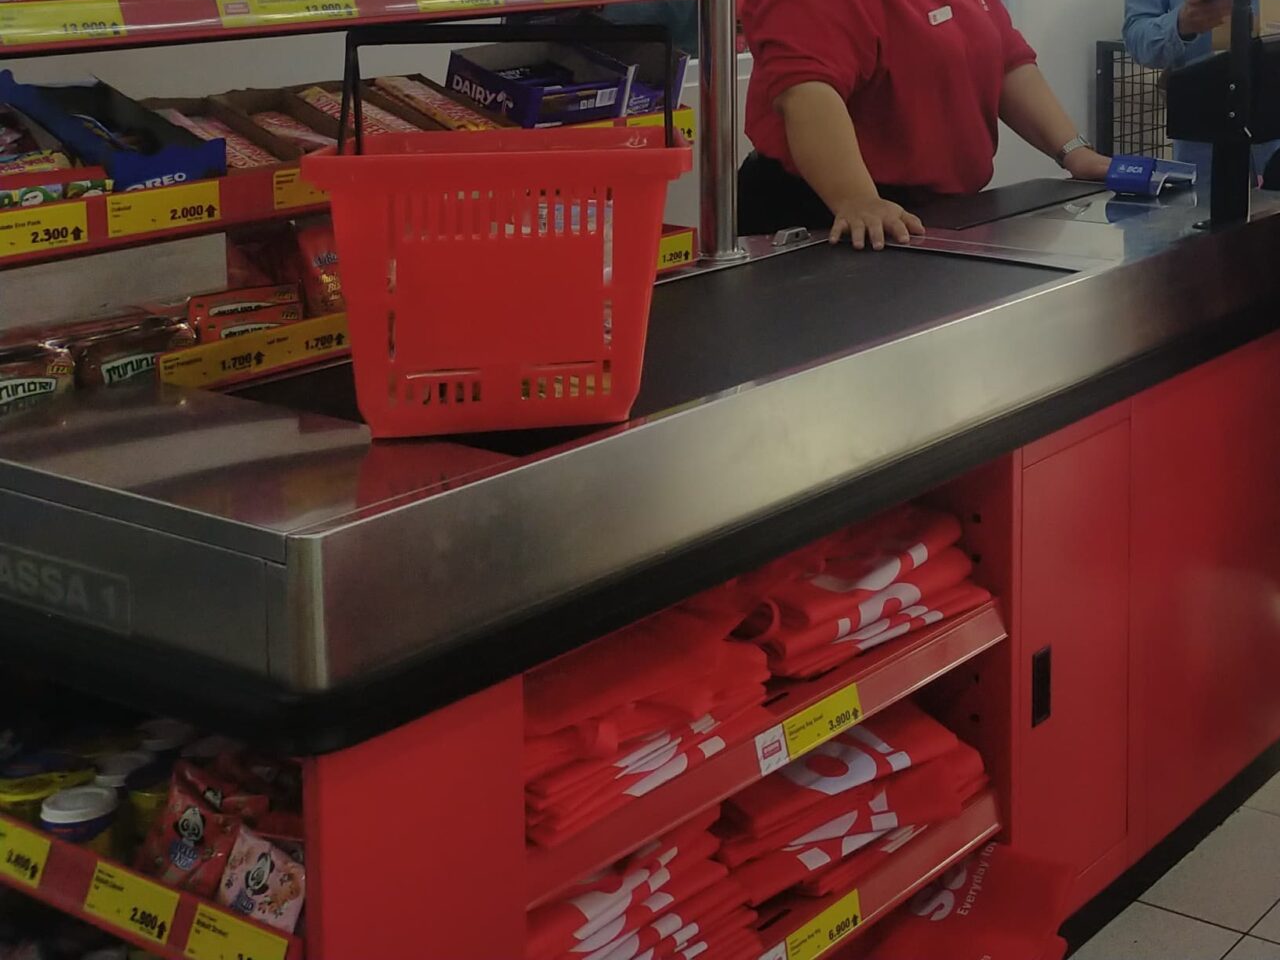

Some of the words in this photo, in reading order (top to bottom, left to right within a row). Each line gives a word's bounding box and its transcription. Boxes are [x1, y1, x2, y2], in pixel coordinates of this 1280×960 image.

[452, 74, 496, 106] DAIRY
[170, 205, 203, 220] 2.000
[31, 227, 68, 243] 2.300
[828, 709, 850, 731] 3.900
[957, 860, 990, 917] Everyday
